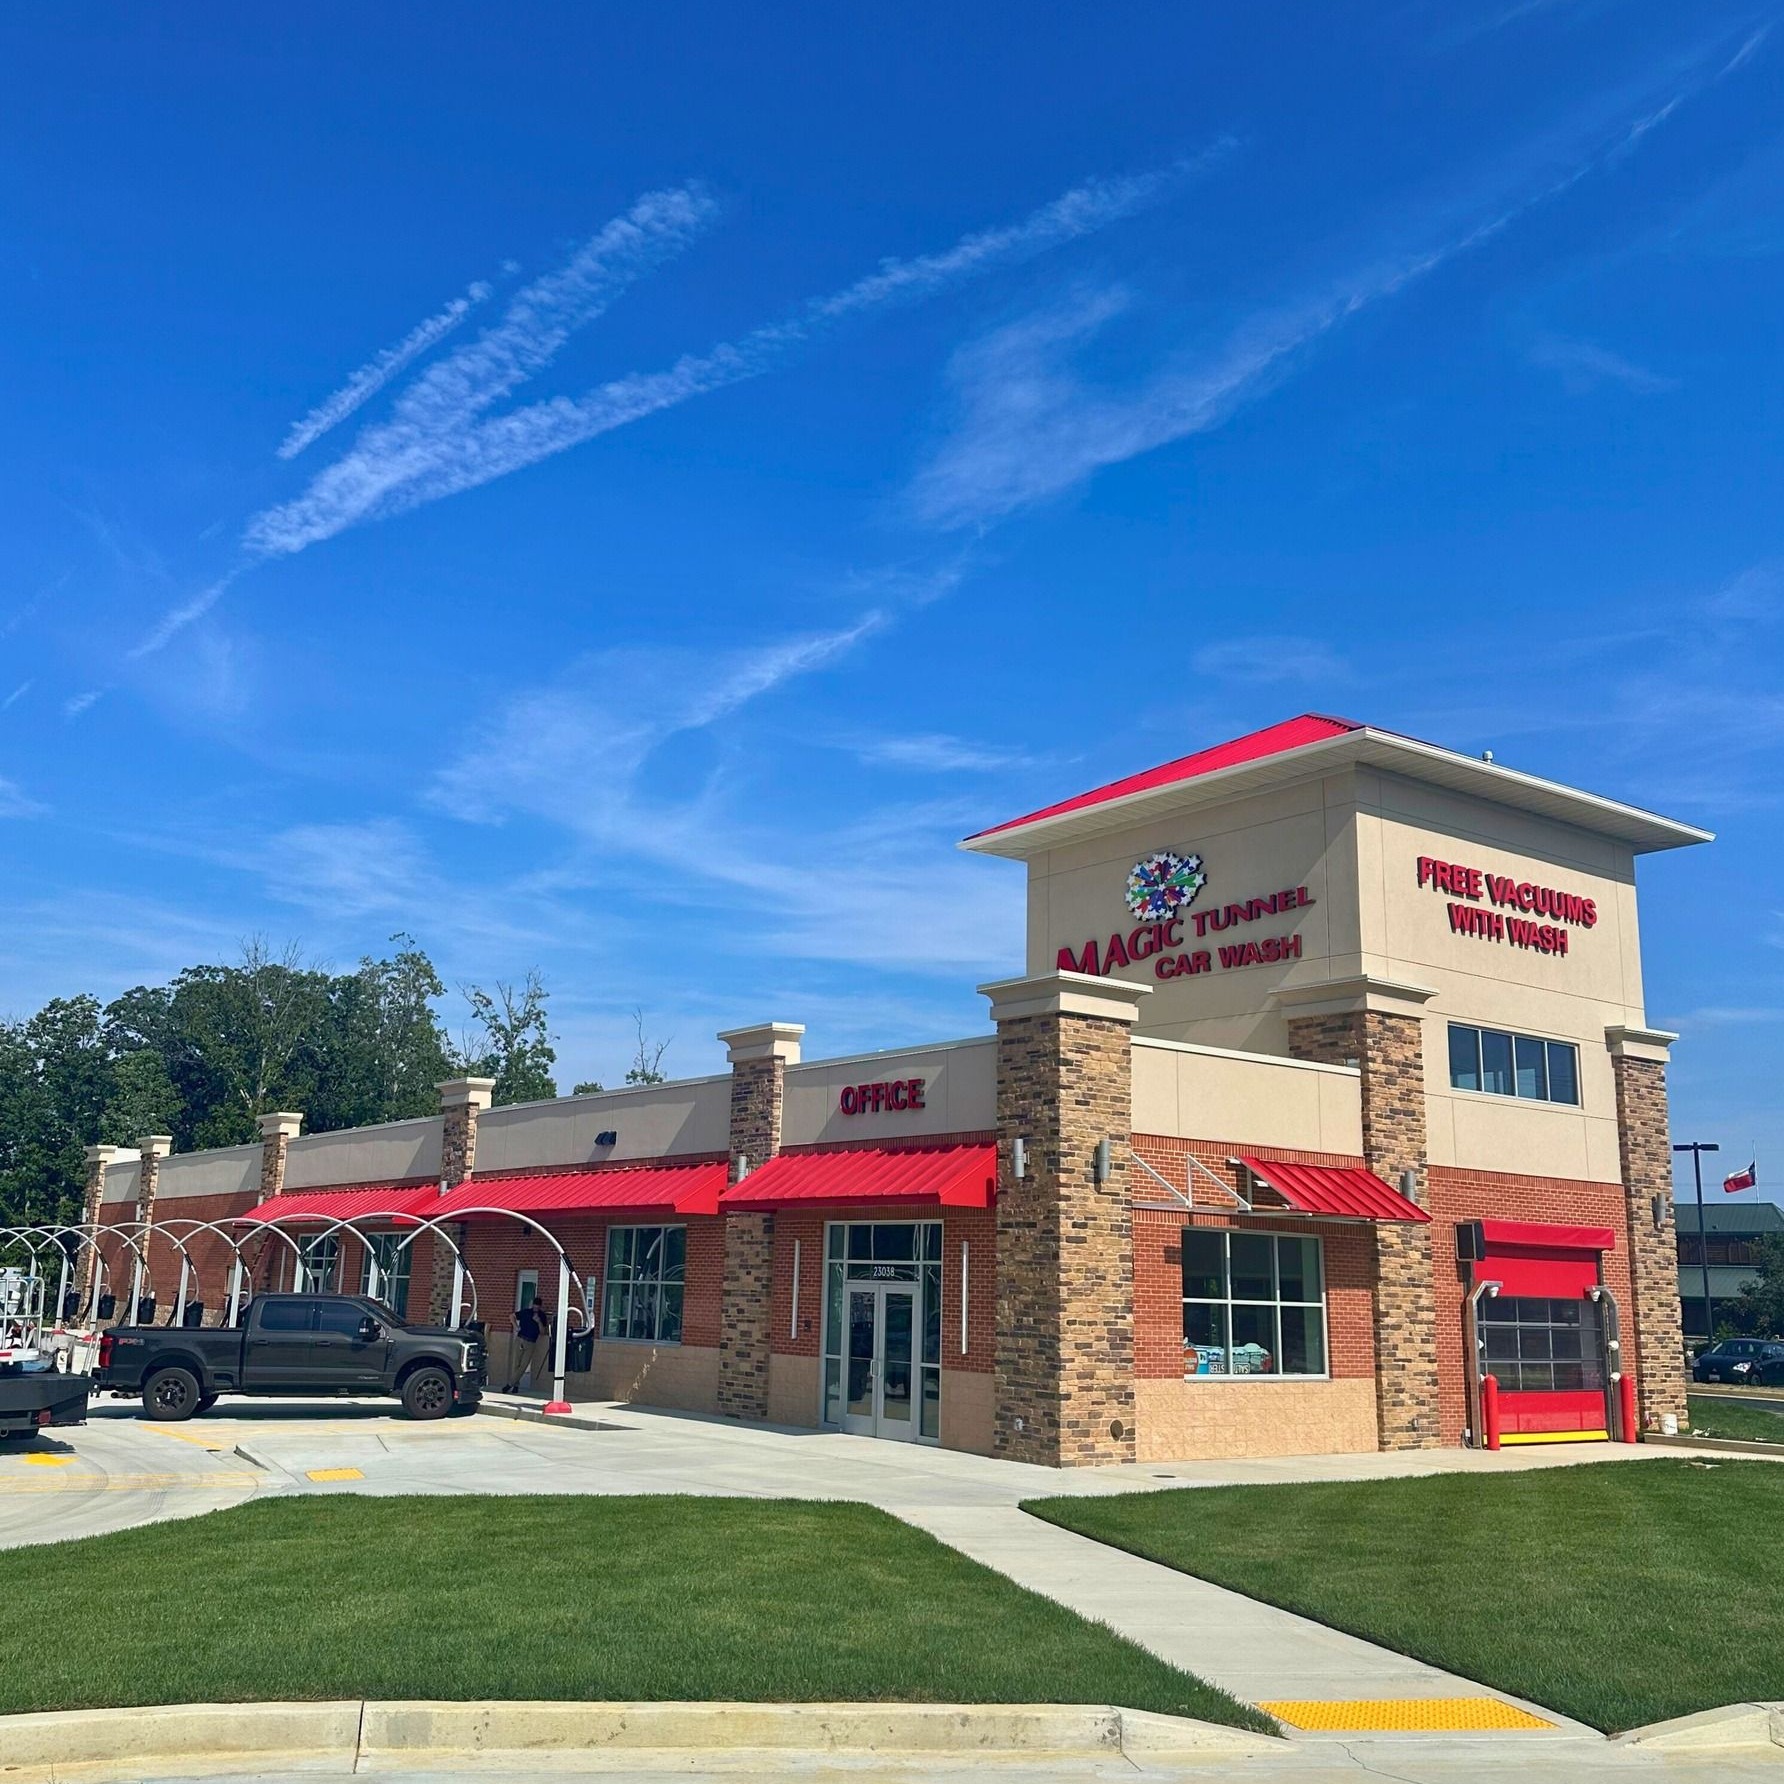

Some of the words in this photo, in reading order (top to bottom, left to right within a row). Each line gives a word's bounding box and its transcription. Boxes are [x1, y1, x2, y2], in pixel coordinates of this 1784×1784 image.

[1417, 856, 1484, 898] FREE
[1485, 874, 1598, 926] VACUUMS
[1056, 918, 1184, 976] MAGIC
[1191, 886, 1316, 937] TUNNEL
[1447, 903, 1505, 940] WITH
[1506, 917, 1569, 954] WASH
[1155, 951, 1212, 980] CAR
[1218, 934, 1302, 969] WASH
[840, 1078, 926, 1116] OFFICE
[873, 1266, 895, 1277] 23038
